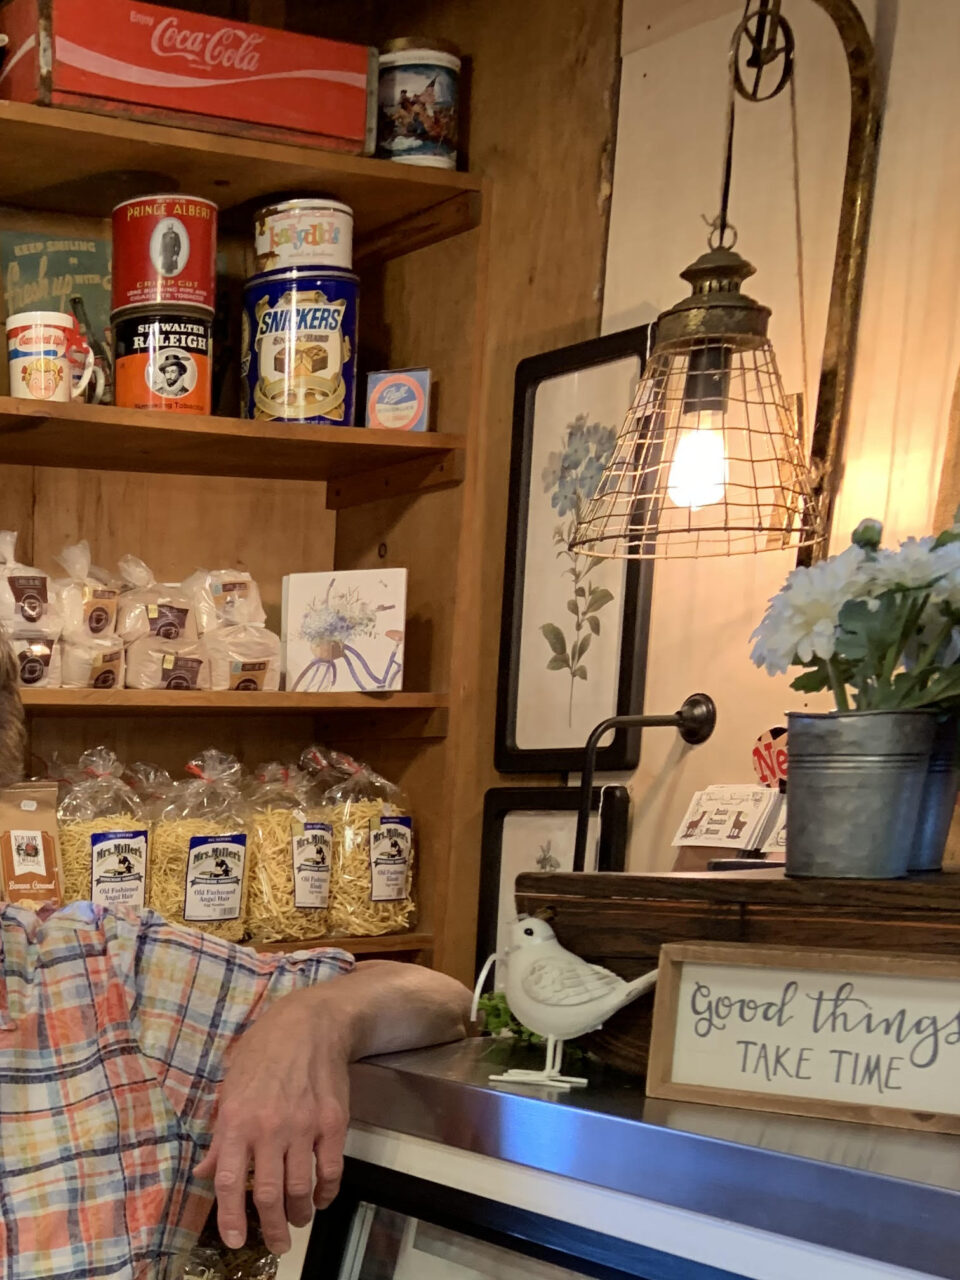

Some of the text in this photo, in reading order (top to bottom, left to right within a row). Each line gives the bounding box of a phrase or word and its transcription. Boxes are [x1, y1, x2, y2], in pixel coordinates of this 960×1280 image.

[151, 17, 265, 71] Coca-Cola
[127, 203, 211, 221] PRINCE ALBERT
[160, 322, 205, 334] WALTER
[259, 307, 341, 335] SNICKERS
[133, 335, 207, 350] RALEIGH
[752, 742, 788, 783] Ne
[373, 831, 386, 843] Mrs.
[96, 844, 143, 862] Mrs. Miller's
[193, 847, 242, 864] Mrs. Miller's
[691, 981, 960, 1068] Good things
[737, 1041, 905, 1094] TAKE TIME
